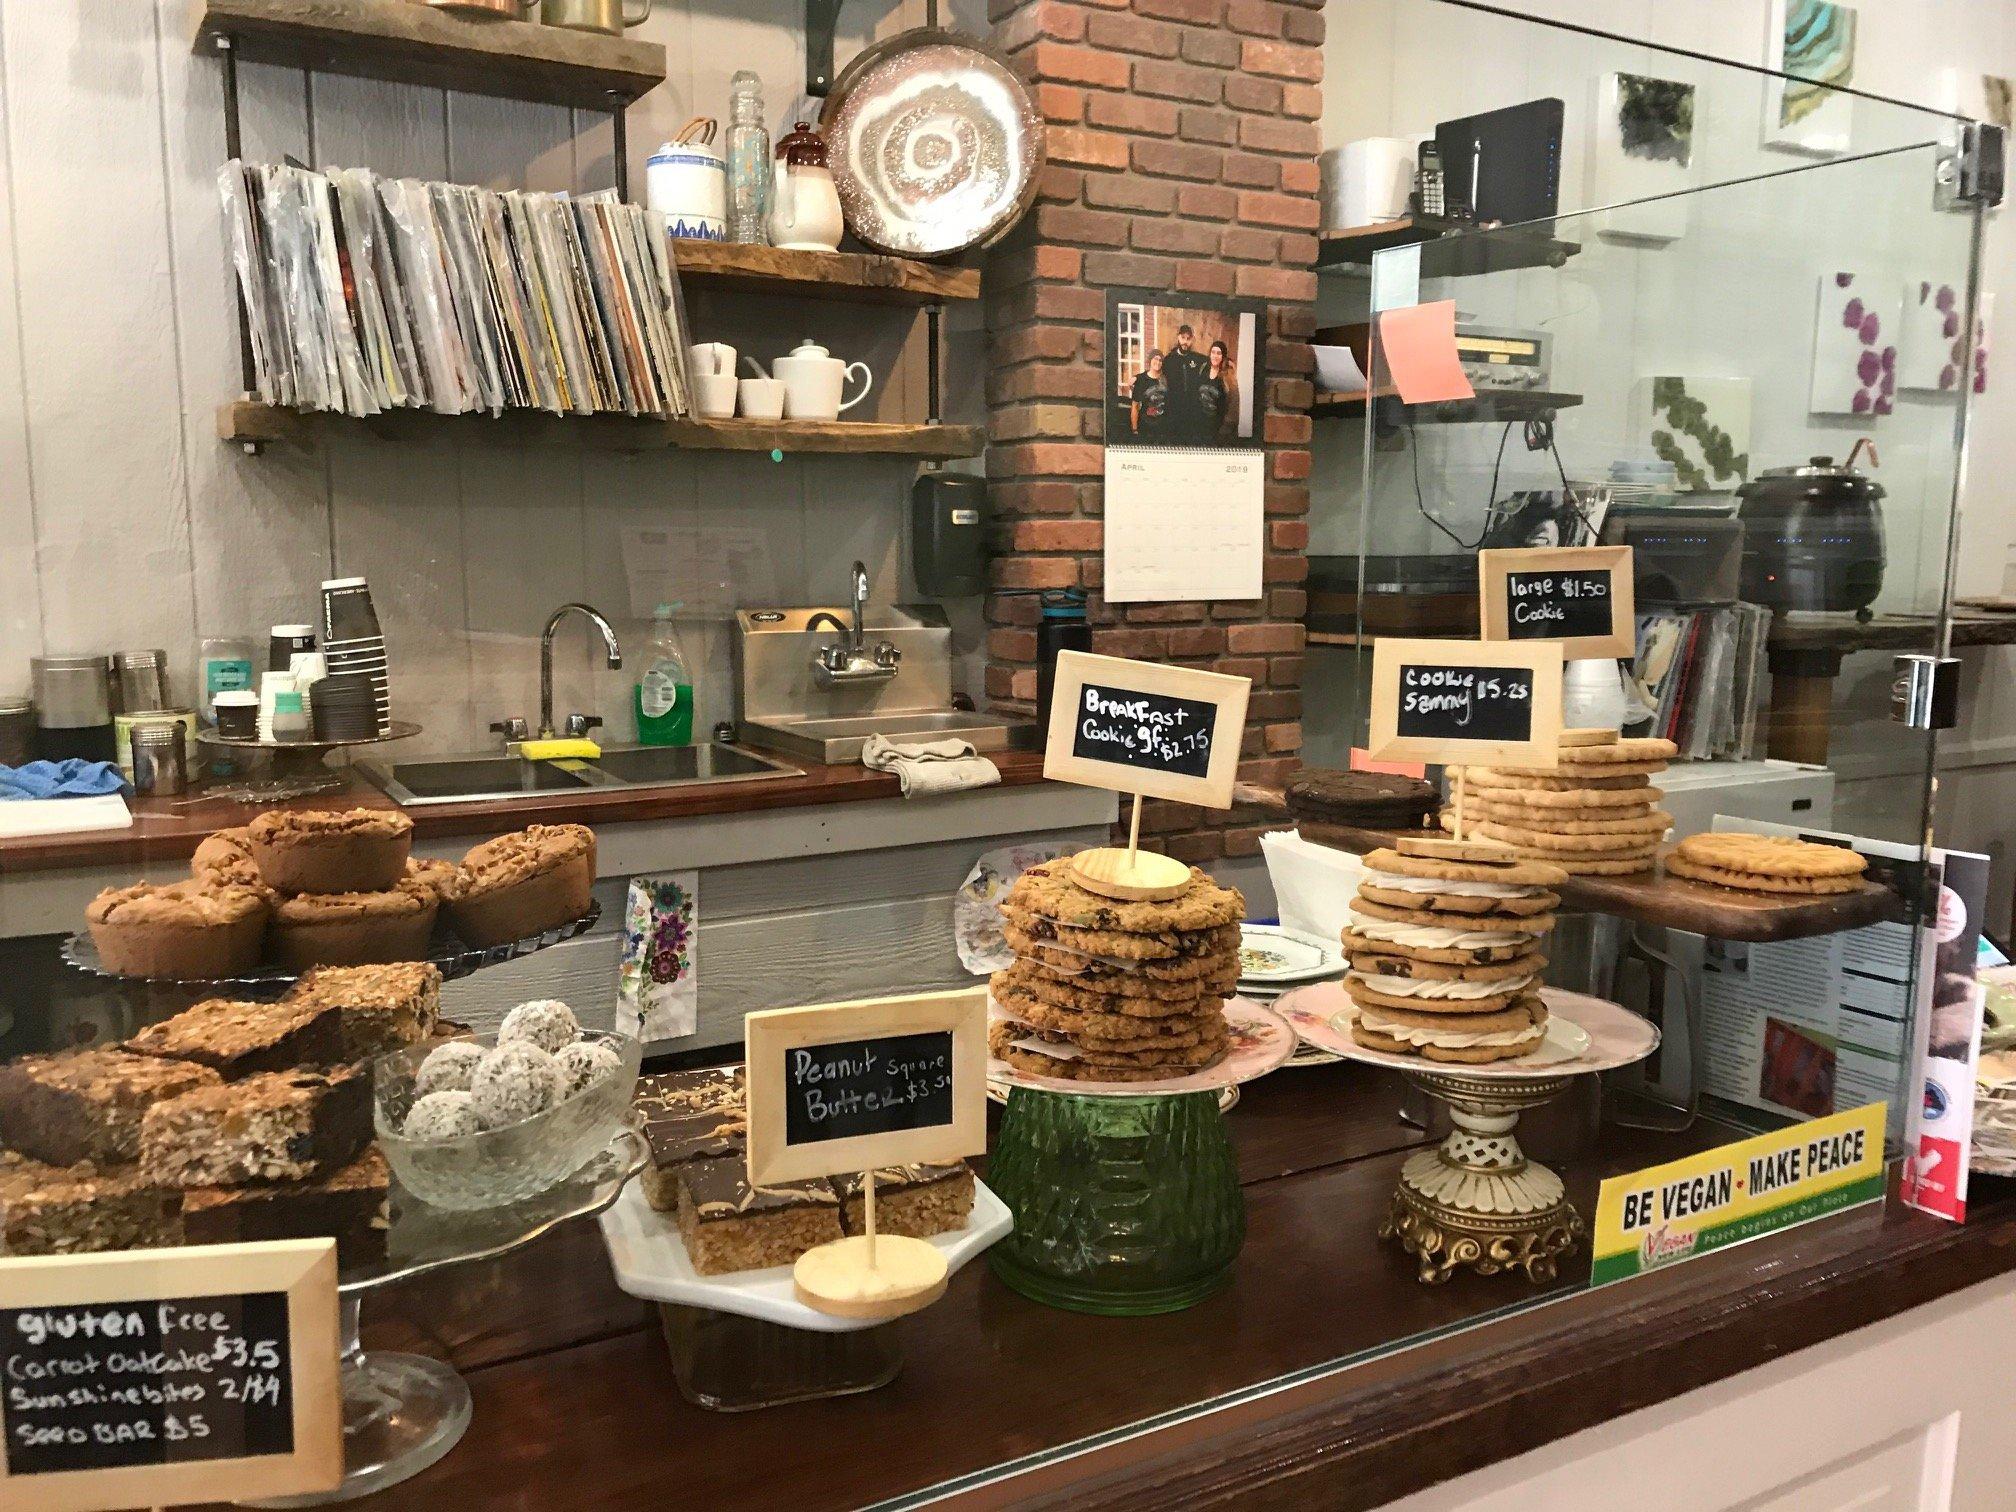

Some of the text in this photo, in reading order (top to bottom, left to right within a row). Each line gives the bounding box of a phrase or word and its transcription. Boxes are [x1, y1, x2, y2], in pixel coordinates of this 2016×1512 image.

[1121, 463, 1146, 472] APRIL
[1510, 576, 1607, 598] large $1.50
[1514, 601, 1565, 624] Cookie
[1160, 728, 1209, 762] $2.75
[795, 1048, 877, 1085] Peanut
[1623, 1129, 1865, 1230] BE VEGAN MAKE PEACE
[7, 1352, 101, 1380] Carrot
